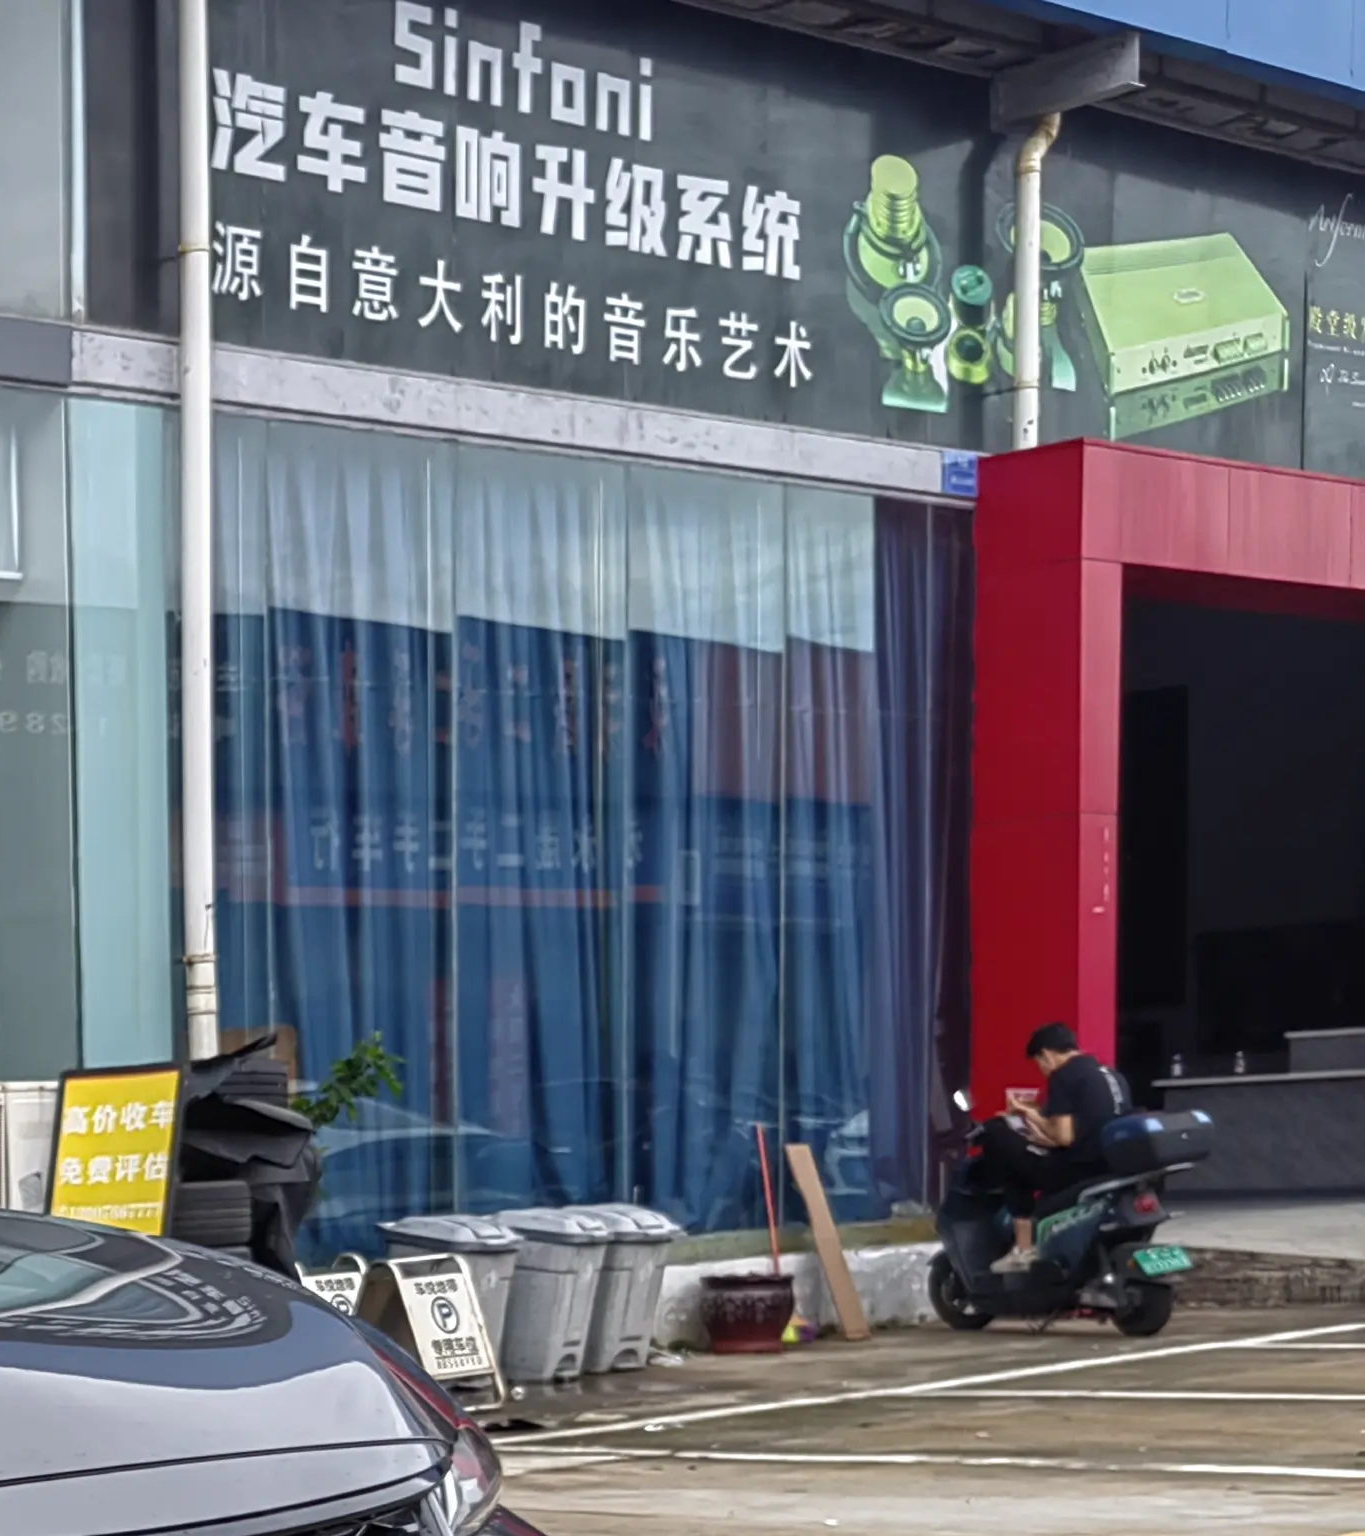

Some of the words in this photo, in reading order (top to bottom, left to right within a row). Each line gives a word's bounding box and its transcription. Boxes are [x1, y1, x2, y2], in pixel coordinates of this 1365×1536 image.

[393, 0, 654, 141] Sinfoni
[211, 66, 802, 282] 汽车音响升级系统
[212, 220, 813, 389] 源自意大利的音乐艺术
[61, 1099, 174, 1135] 高价收车
[60, 1152, 169, 1185] 免费评估
[435, 1302, 453, 1329] P
